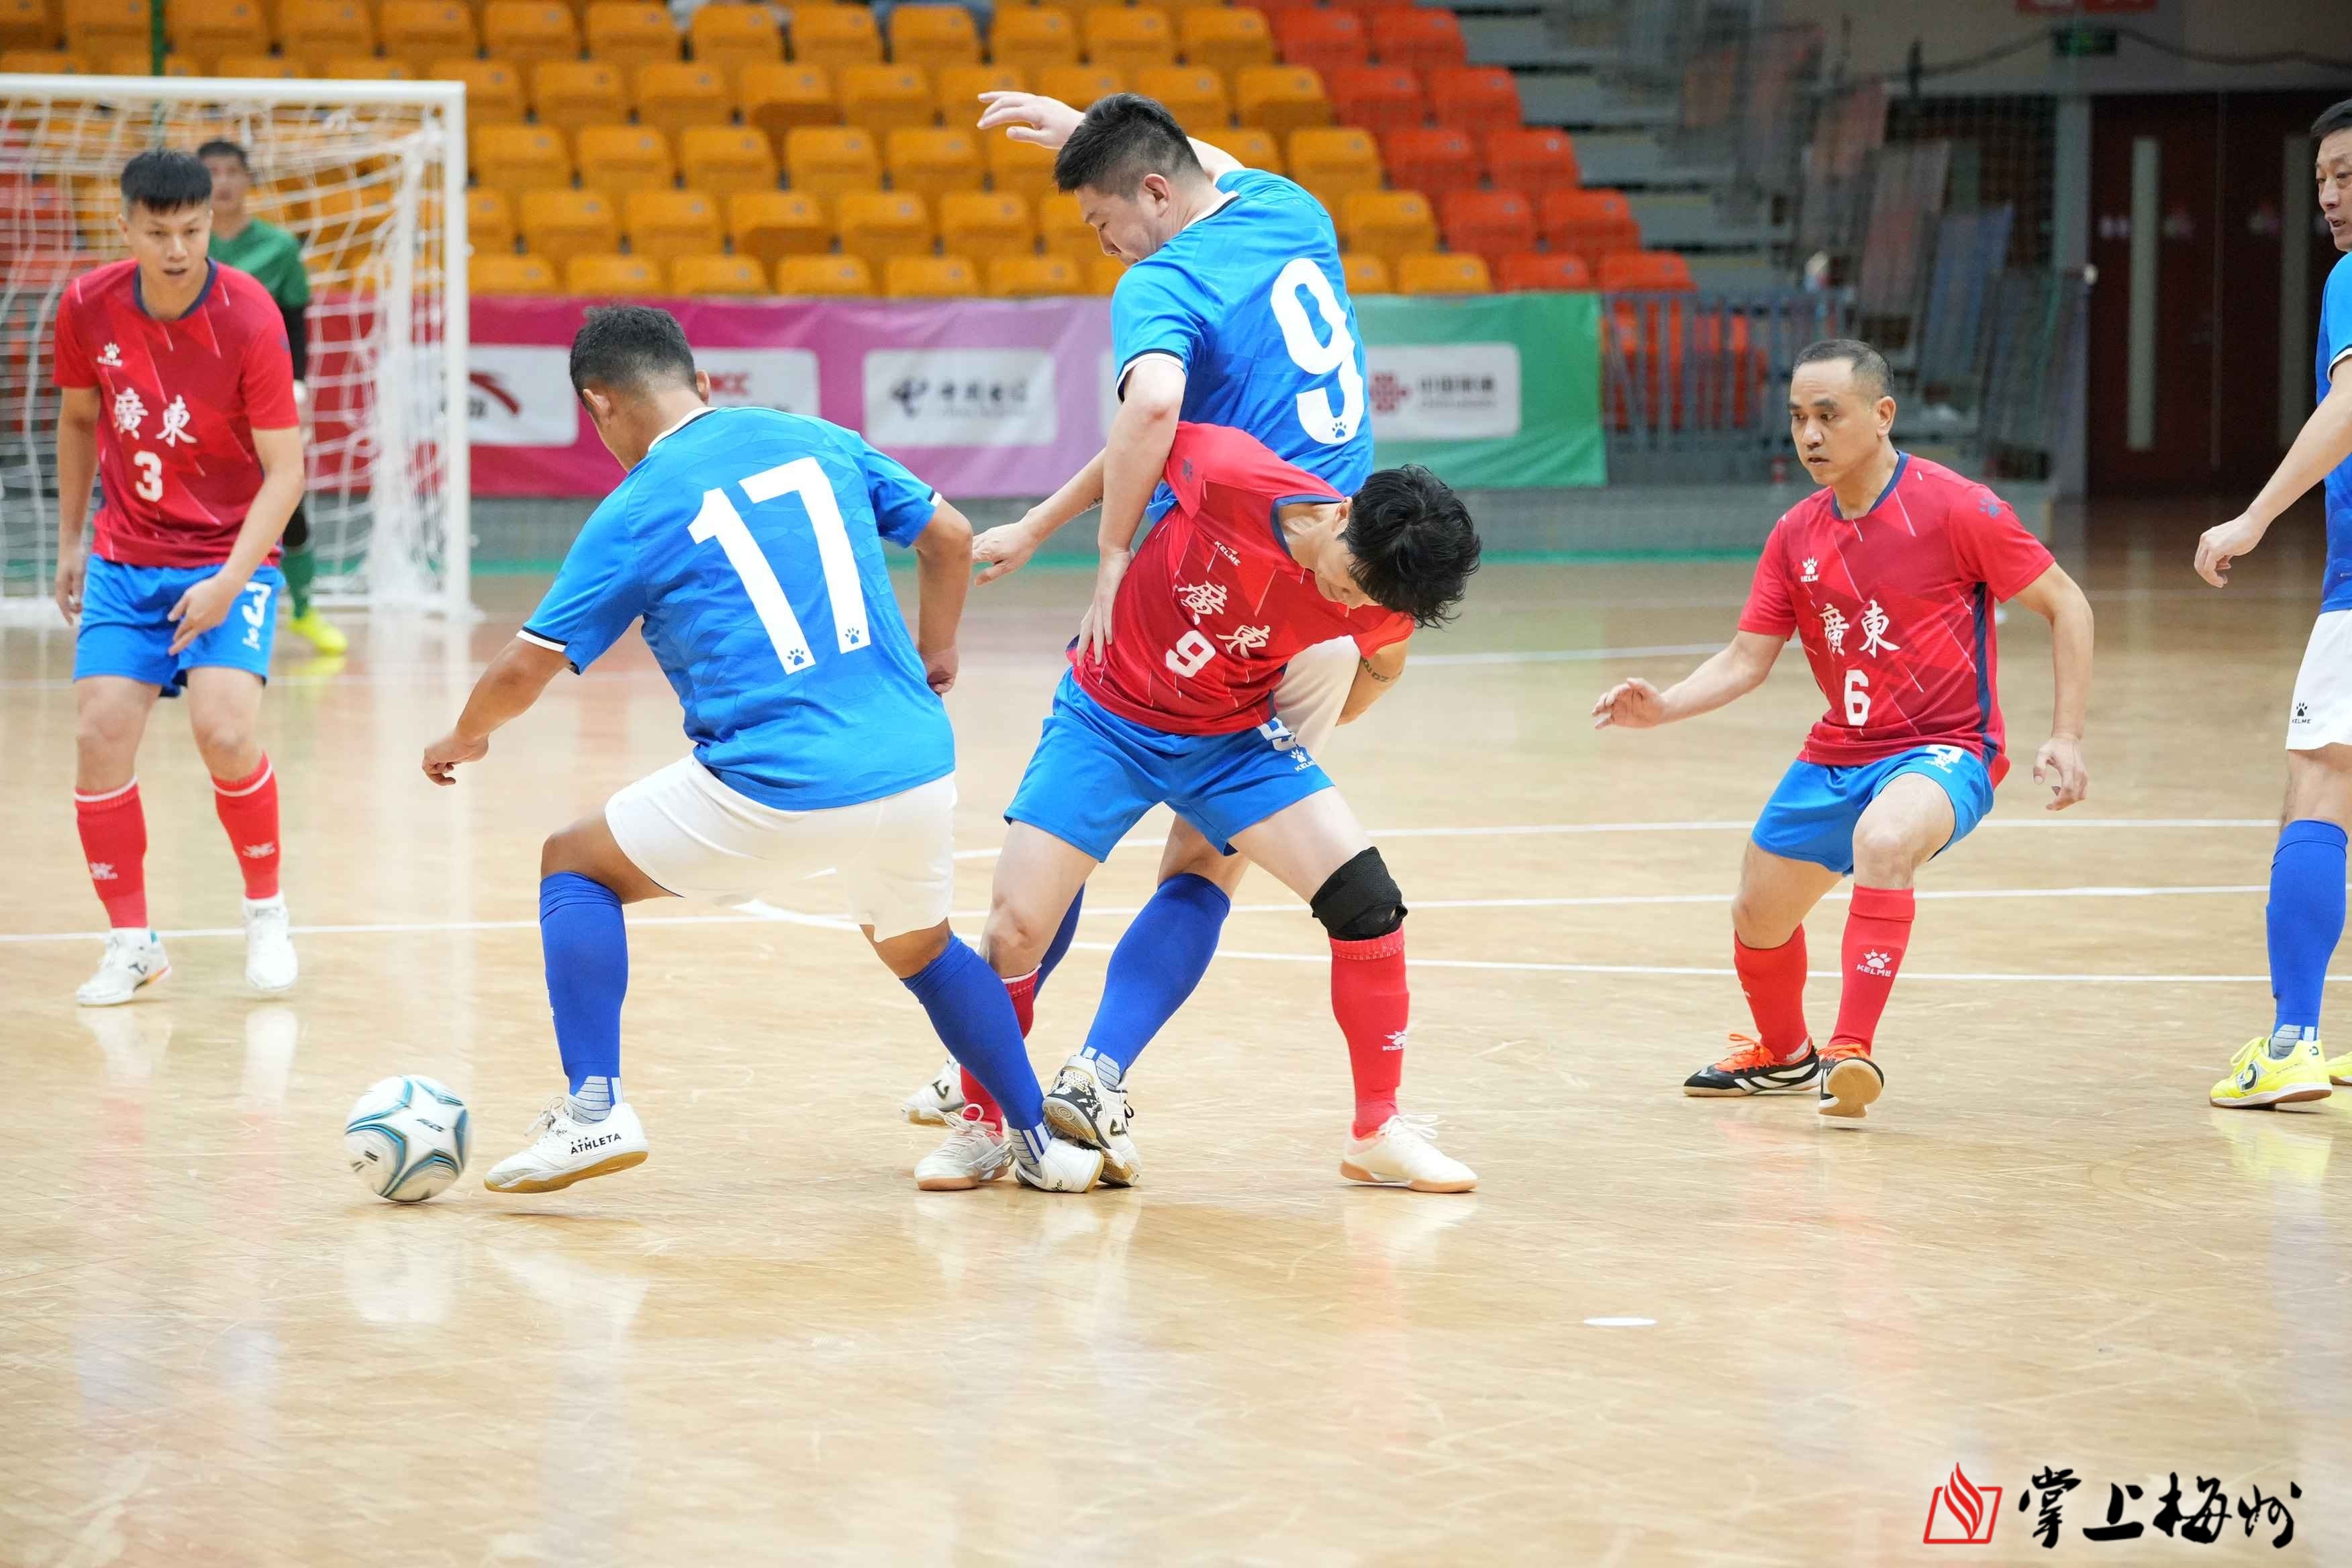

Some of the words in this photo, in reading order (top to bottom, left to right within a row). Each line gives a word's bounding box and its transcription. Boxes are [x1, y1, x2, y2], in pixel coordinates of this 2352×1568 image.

[1270, 258, 1365, 444] 9
[134, 450, 163, 502] 3
[687, 457, 871, 675] 17
[1214, 540, 1241, 567] KELME
[1165, 630, 1216, 678] 9
[1820, 599, 1901, 658] 廣東
[1844, 669, 1871, 726] 6
[1856, 964, 1892, 977] KELME
[571, 1133, 622, 1155] ATHLETA
